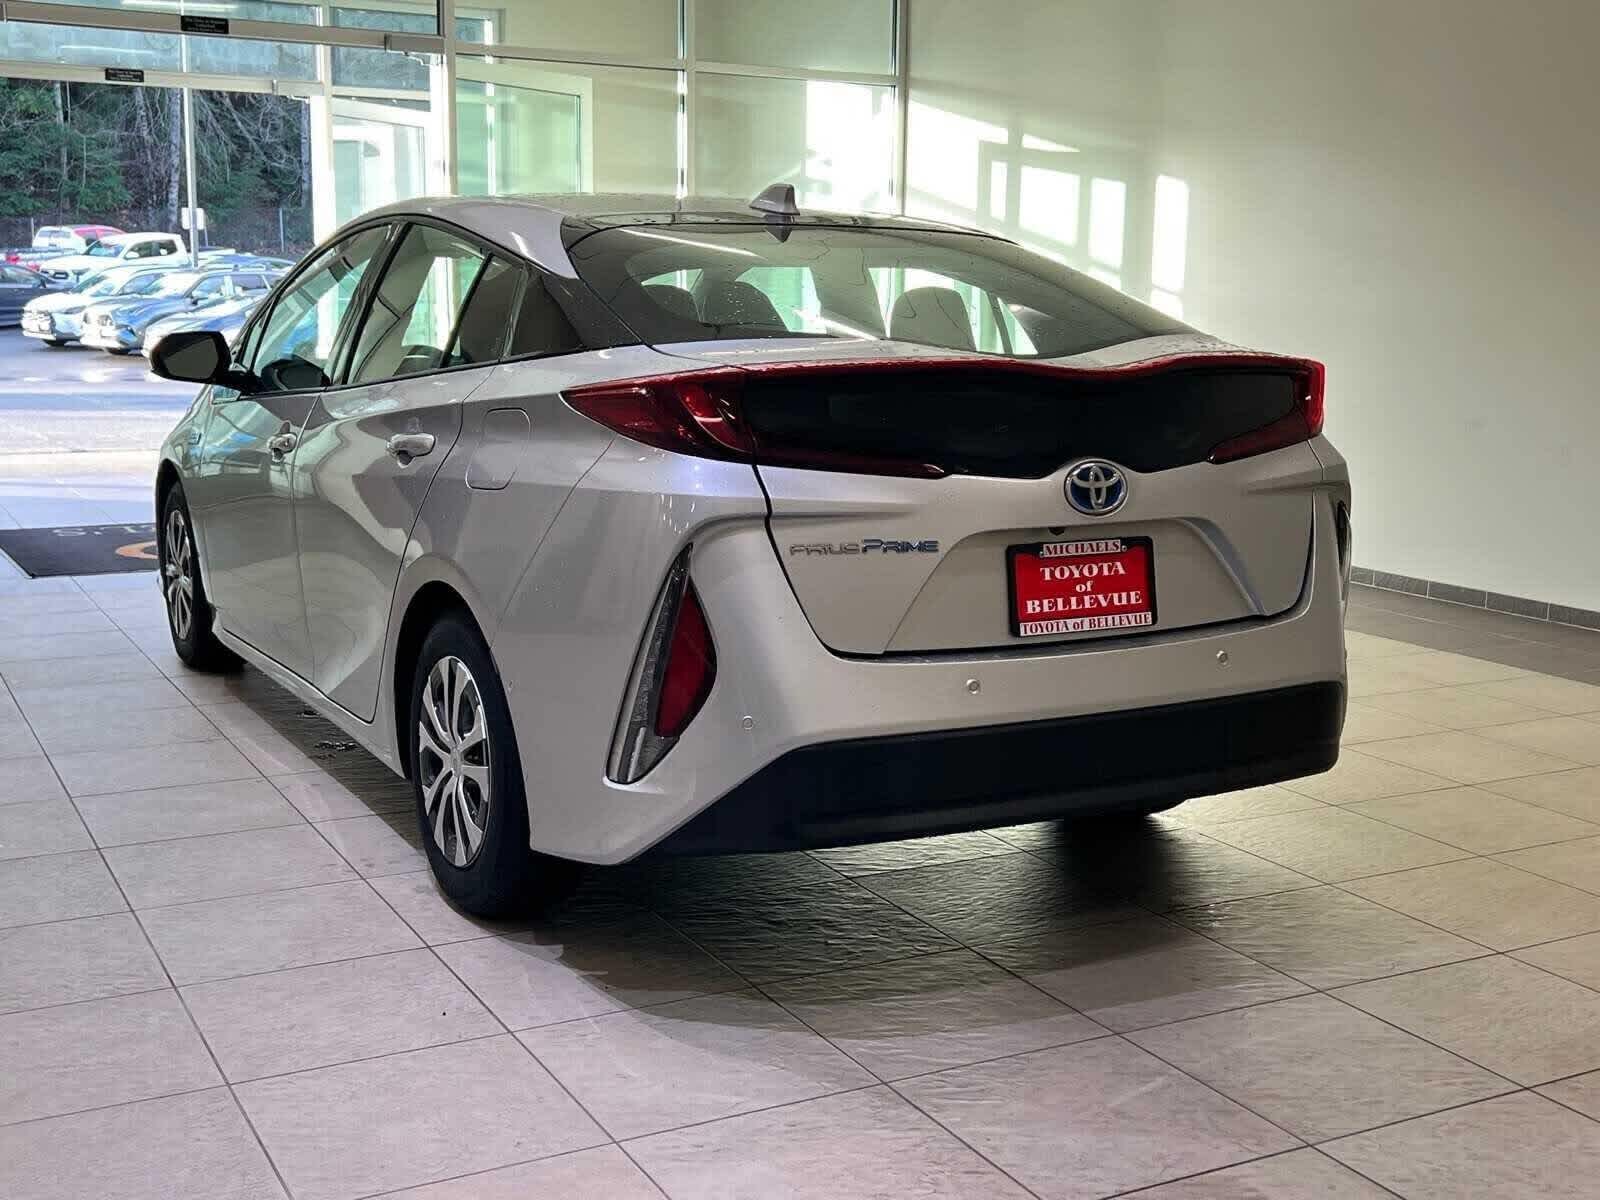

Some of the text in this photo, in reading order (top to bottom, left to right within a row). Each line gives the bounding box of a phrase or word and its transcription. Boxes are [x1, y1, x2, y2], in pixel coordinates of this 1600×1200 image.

[862, 538, 939, 554] PRIME
[1045, 541, 1120, 556] MICHAELS
[1040, 561, 1126, 581] TOYOTA
[1075, 581, 1094, 593] of
[1026, 590, 1143, 614] BELLEVUE
[1022, 613, 1152, 635] TOYOTA of BELLEVUE
